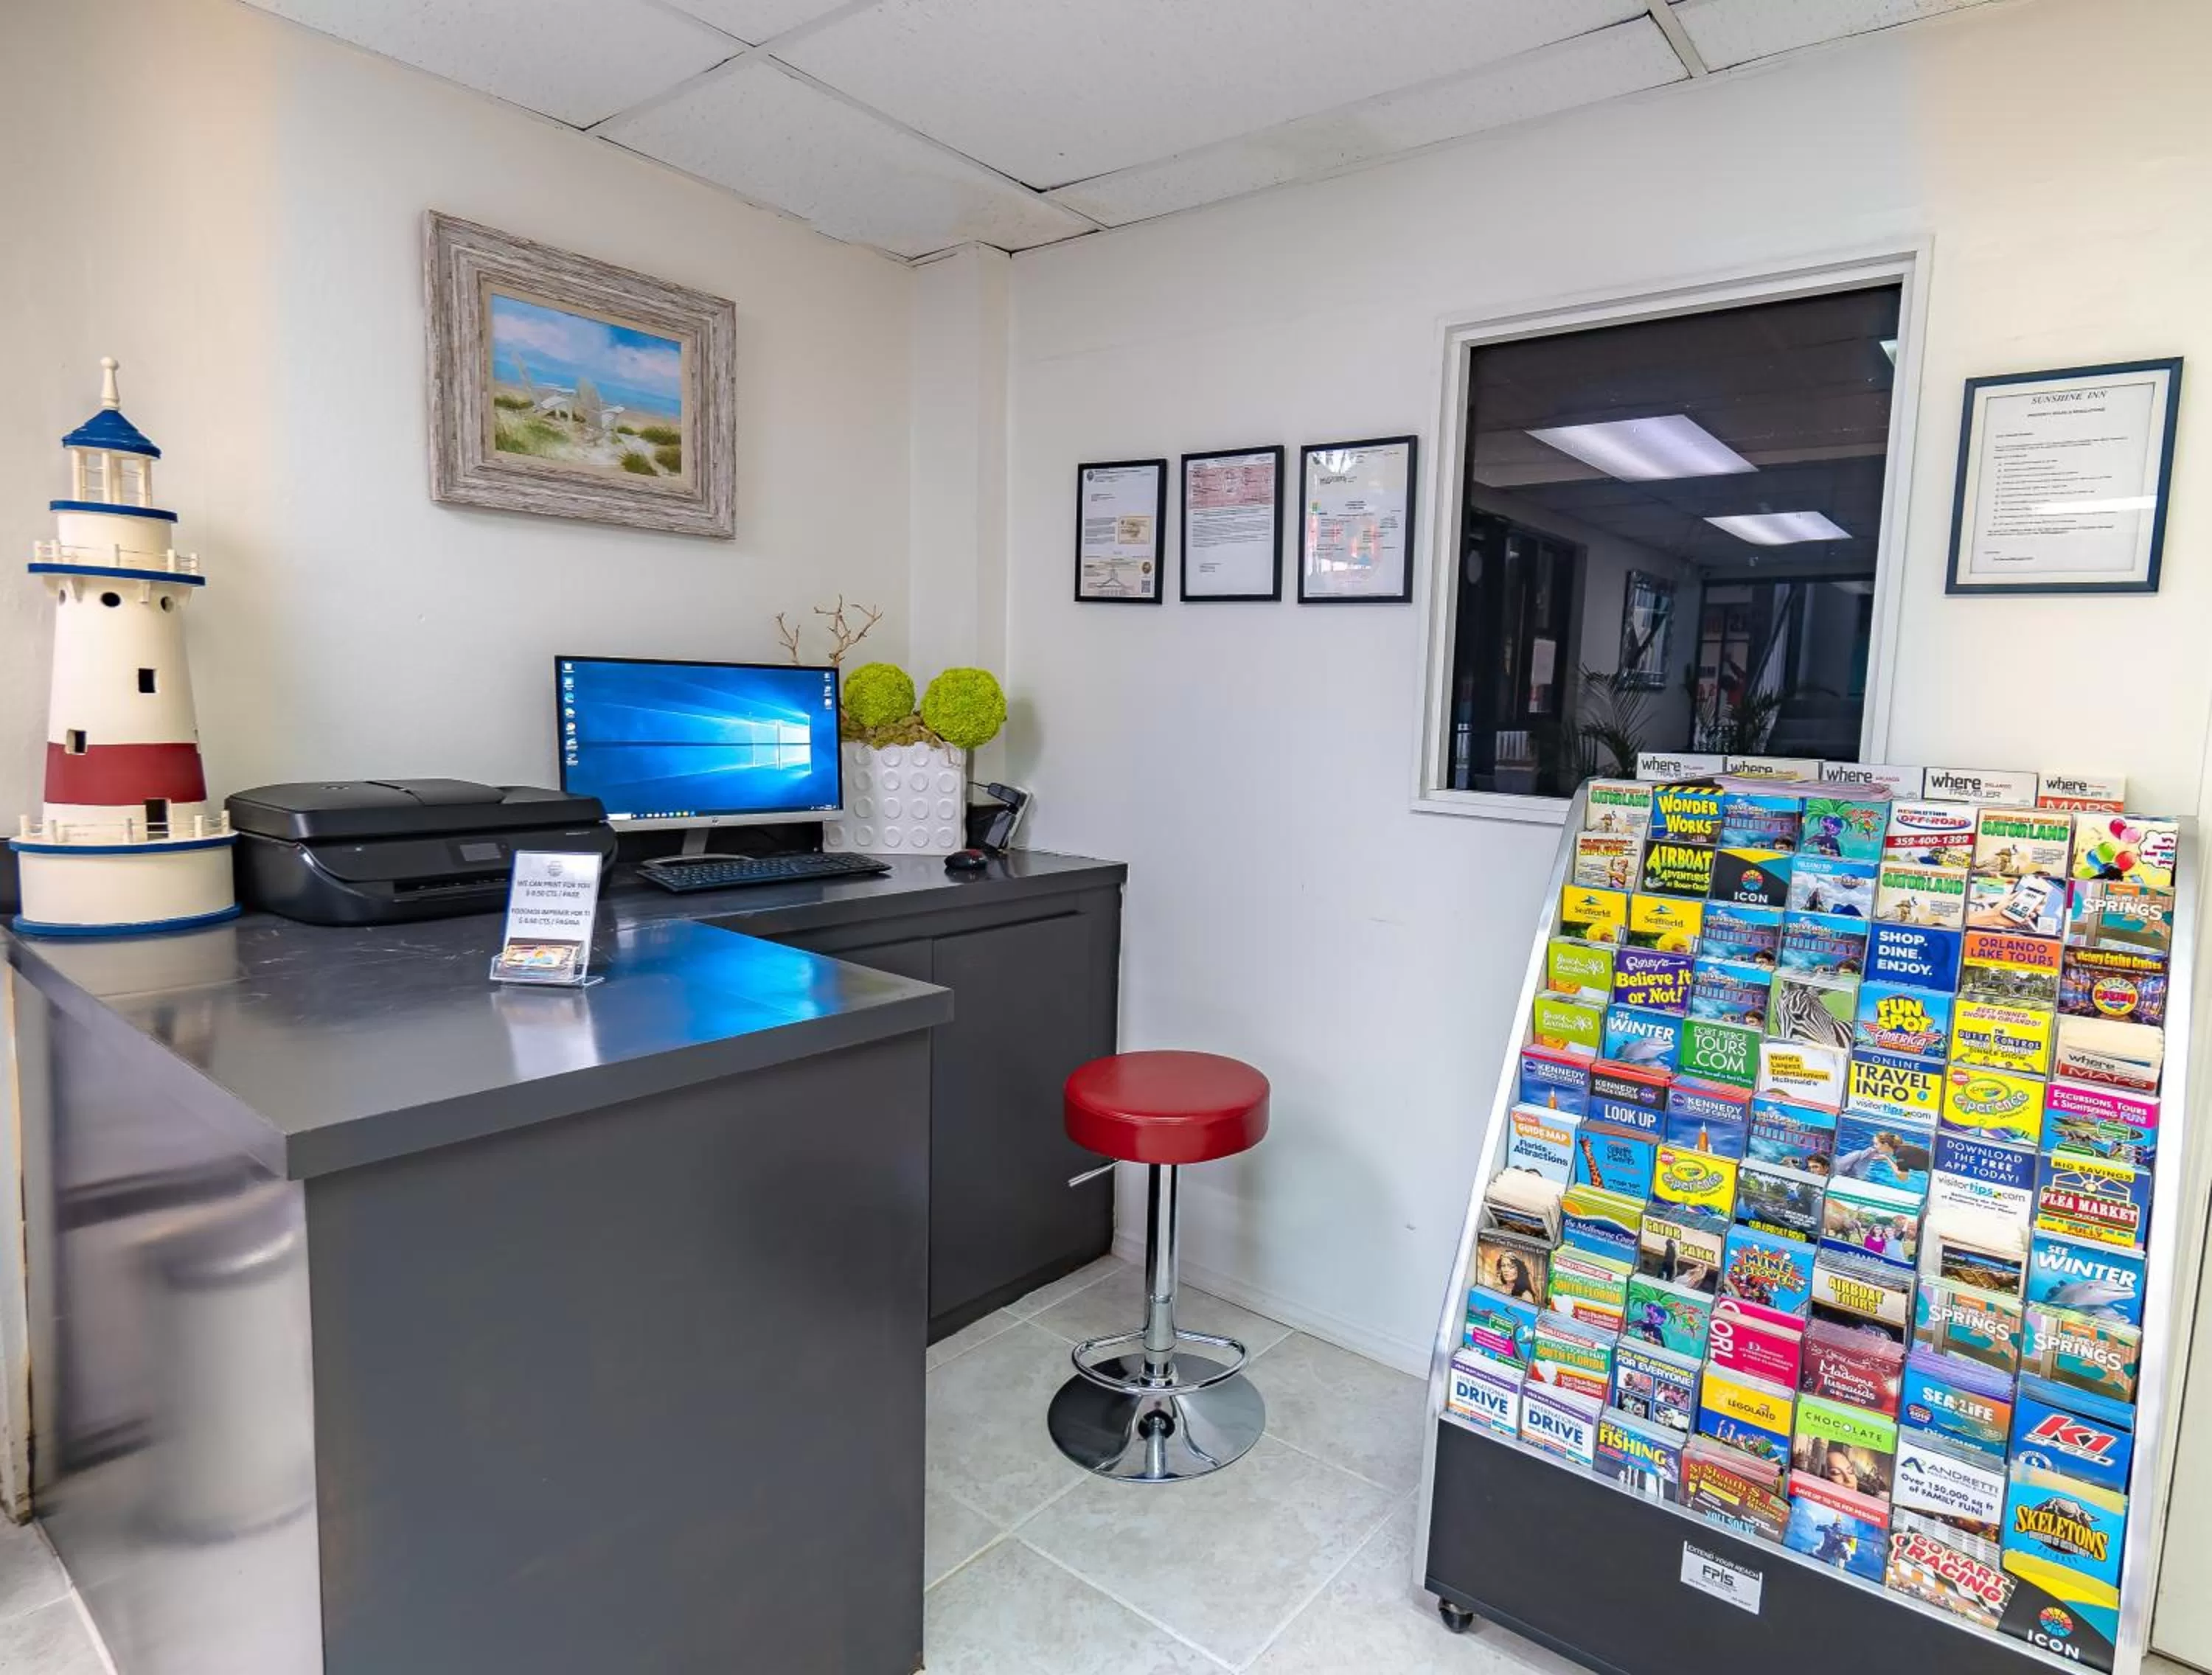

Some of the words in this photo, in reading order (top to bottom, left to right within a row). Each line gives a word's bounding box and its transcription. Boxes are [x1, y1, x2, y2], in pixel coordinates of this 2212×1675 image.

[1641, 757, 1681, 772] where
[1826, 766, 1872, 783] where
[1931, 772, 1981, 790] where
[2046, 777, 2087, 791] where
[1658, 794, 1719, 815] WONDER
[1666, 814, 1712, 835] WORKS
[1646, 843, 1713, 874] AIRBOAT
[1734, 891, 1768, 904] ICON
[2083, 899, 2163, 920] SPRINGS
[1978, 937, 2048, 953] ORLANDO
[1971, 948, 2003, 962] LAKE
[2008, 951, 2053, 967] TOURS
[1615, 971, 1672, 988] Believe
[1628, 992, 1646, 1003] or
[1877, 997, 1924, 1016] FUN
[1610, 1018, 1674, 1041] WINTER
[1695, 1035, 1747, 1056] TOURS
[1538, 1063, 1585, 1080] KENNEDY
[1871, 1056, 1921, 1070] ONLINE
[1595, 1079, 1638, 1094] KENNEDY
[1854, 1062, 1932, 1090] TRAVEL
[1856, 1079, 1910, 1101] INFO
[1604, 1104, 1637, 1124] LOOK
[1638, 1110, 1657, 1128] UP
[1687, 1096, 1742, 1115] KENNEDY
[1947, 1140, 2023, 1163] DOWNLOAD
[1954, 1152, 1975, 1166] THE
[1981, 1157, 2013, 1172] FREE
[1944, 1160, 1967, 1174] APP
[2041, 1191, 2074, 1211] FLEA
[2079, 1198, 2137, 1224] MARKET
[2038, 1252, 2138, 1288] WINTER
[1829, 1274, 1884, 1304] AIRBOAT
[1834, 1292, 1877, 1314] TOURS
[1928, 1304, 2010, 1341] SPRINGS
[2034, 1334, 2122, 1371] SPRINGS
[1456, 1381, 1509, 1415] DRIVE
[1922, 1387, 1955, 1411] SEA
[1528, 1410, 1584, 1446] DRIVE
[2034, 1413, 2118, 1454] K1
[1599, 1428, 1667, 1466] FISHING
[1929, 1463, 1999, 1494] ANDRETTI
[2015, 1505, 2109, 1561] SKELETONS
[1913, 1534, 1944, 1555] GO
[1947, 1550, 2007, 1587] KART
[1907, 1545, 2004, 1603] RACING
[2028, 1629, 2080, 1660] ICON
